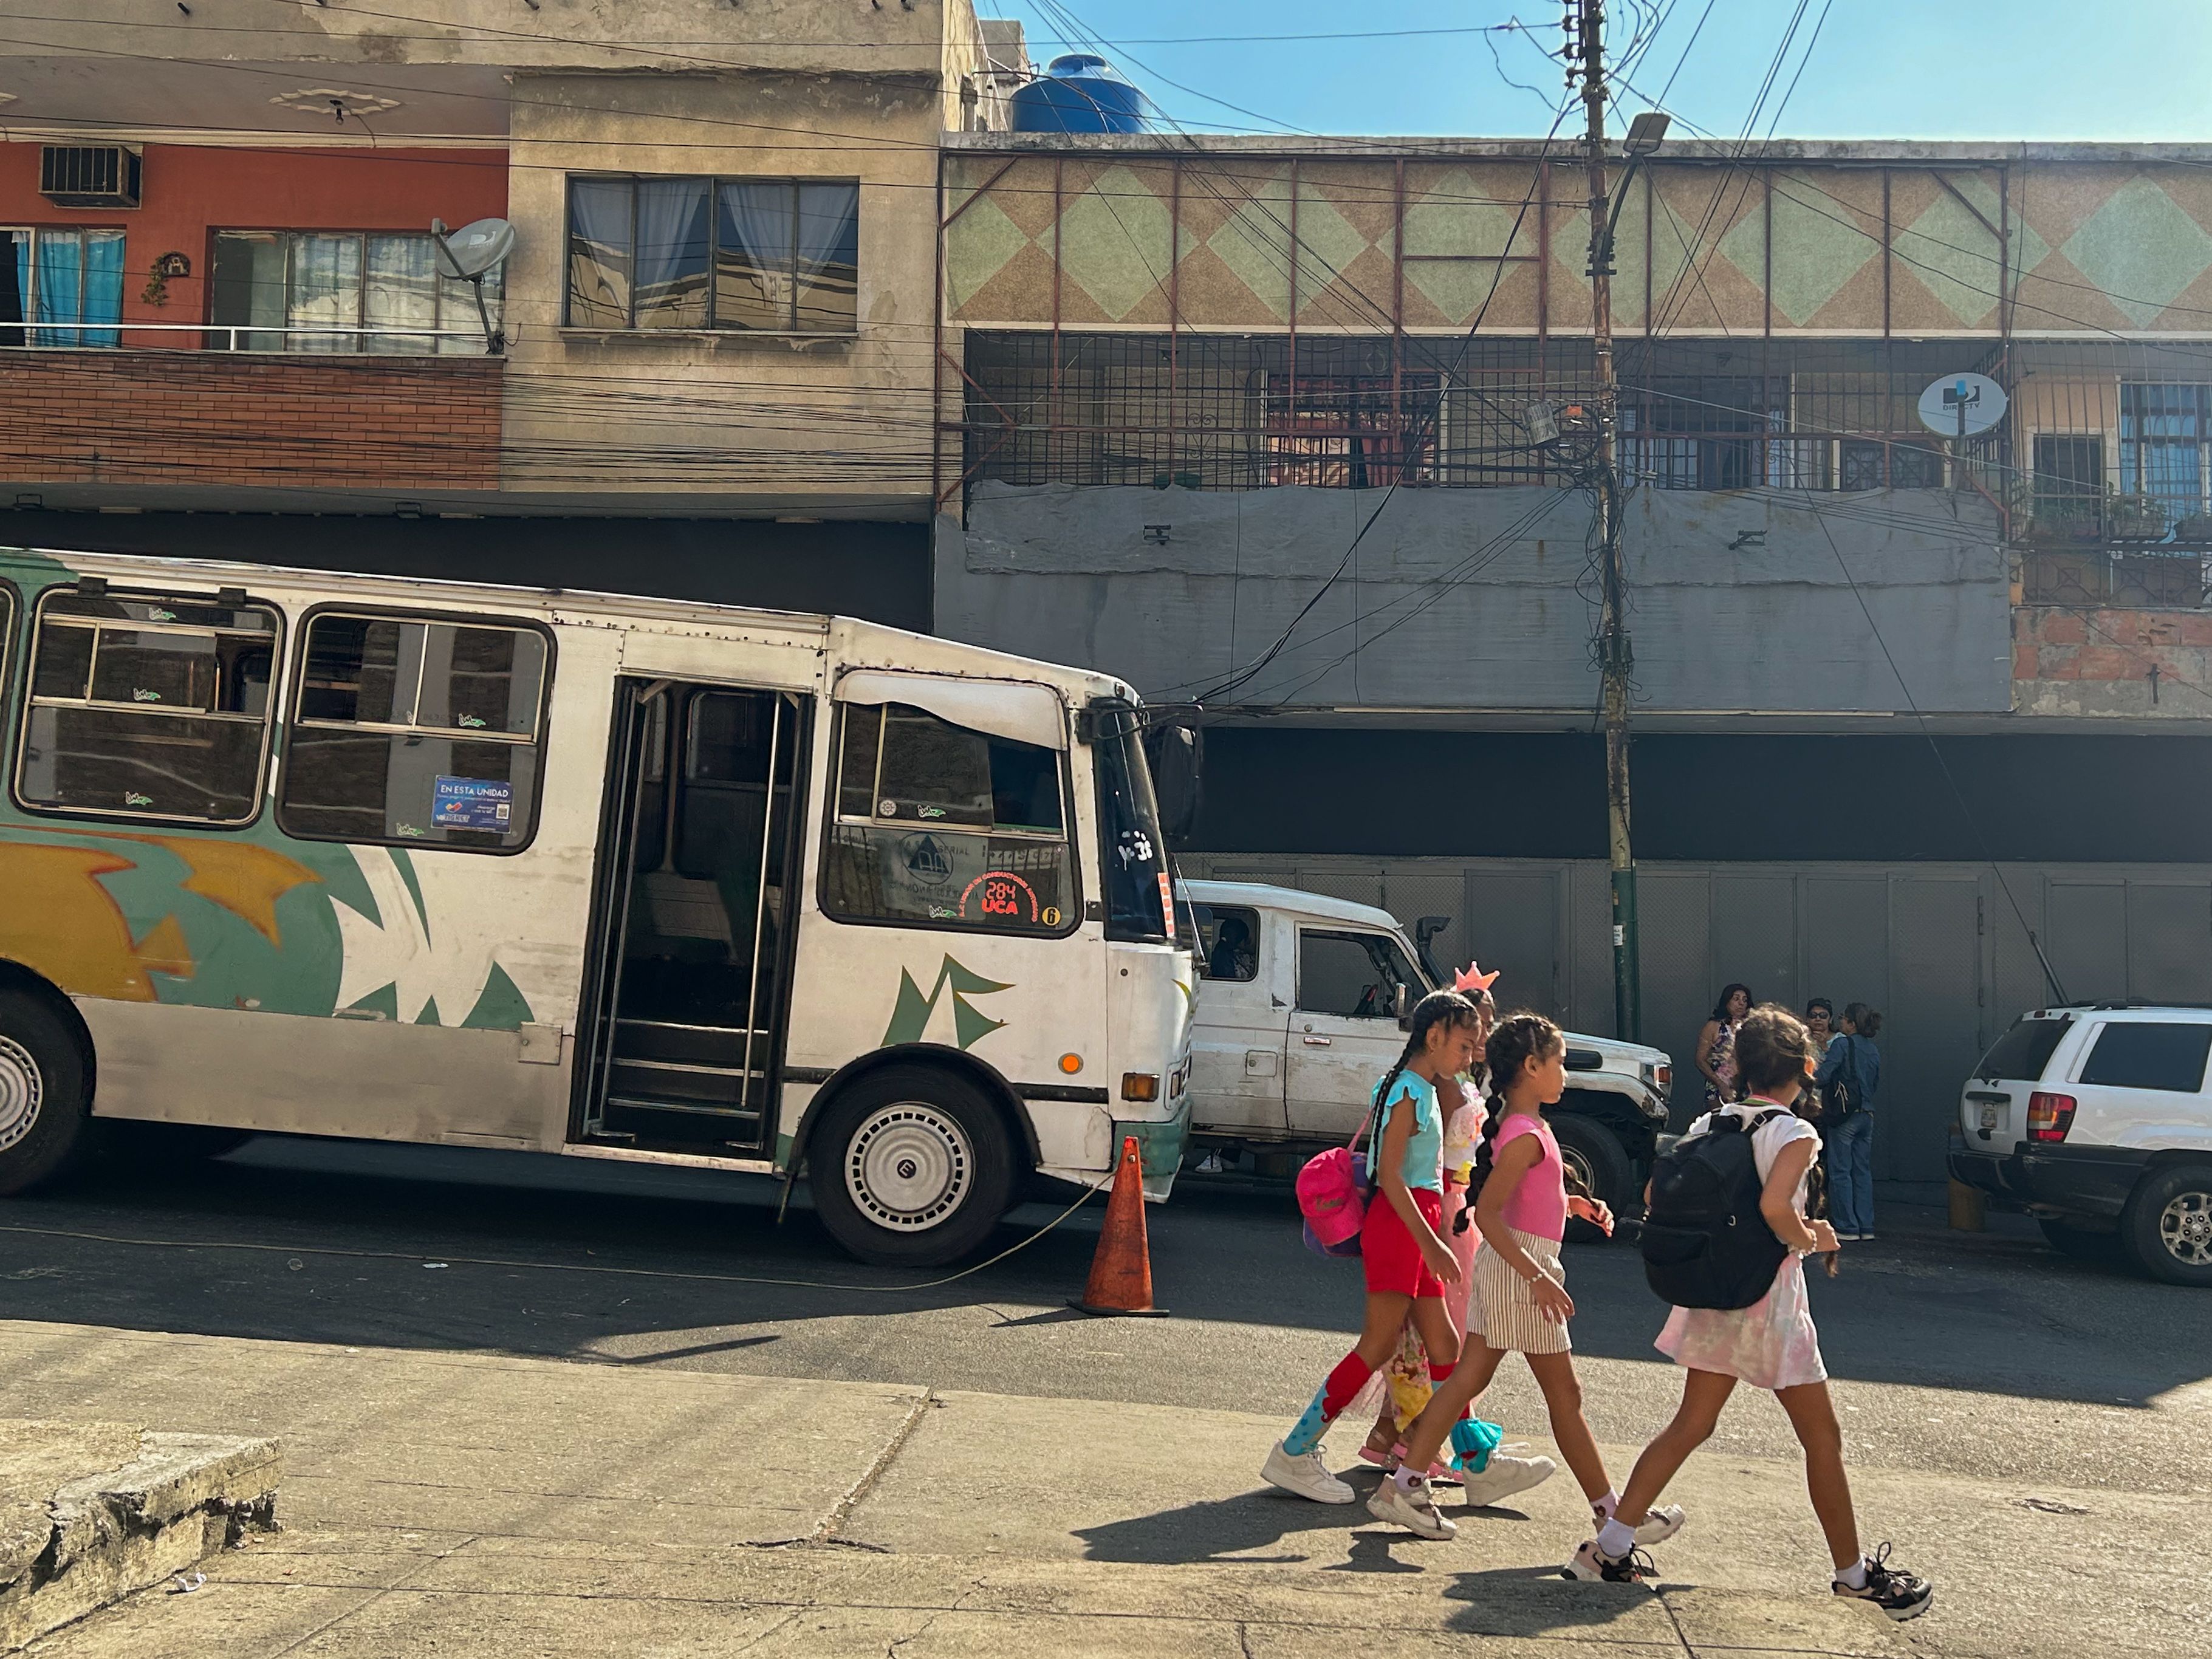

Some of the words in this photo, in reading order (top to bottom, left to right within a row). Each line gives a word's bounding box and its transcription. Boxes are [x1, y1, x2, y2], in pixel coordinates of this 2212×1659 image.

[1943, 402, 1981, 411] DIRCTV
[440, 785, 452, 793] EN
[454, 786, 474, 795] ESTA
[477, 788, 508, 798] UNIDAD
[938, 845, 970, 856] SERIAL
[986, 881, 1016, 900] 284
[982, 898, 1019, 915] UCA
[1047, 908, 1055, 923] 6
